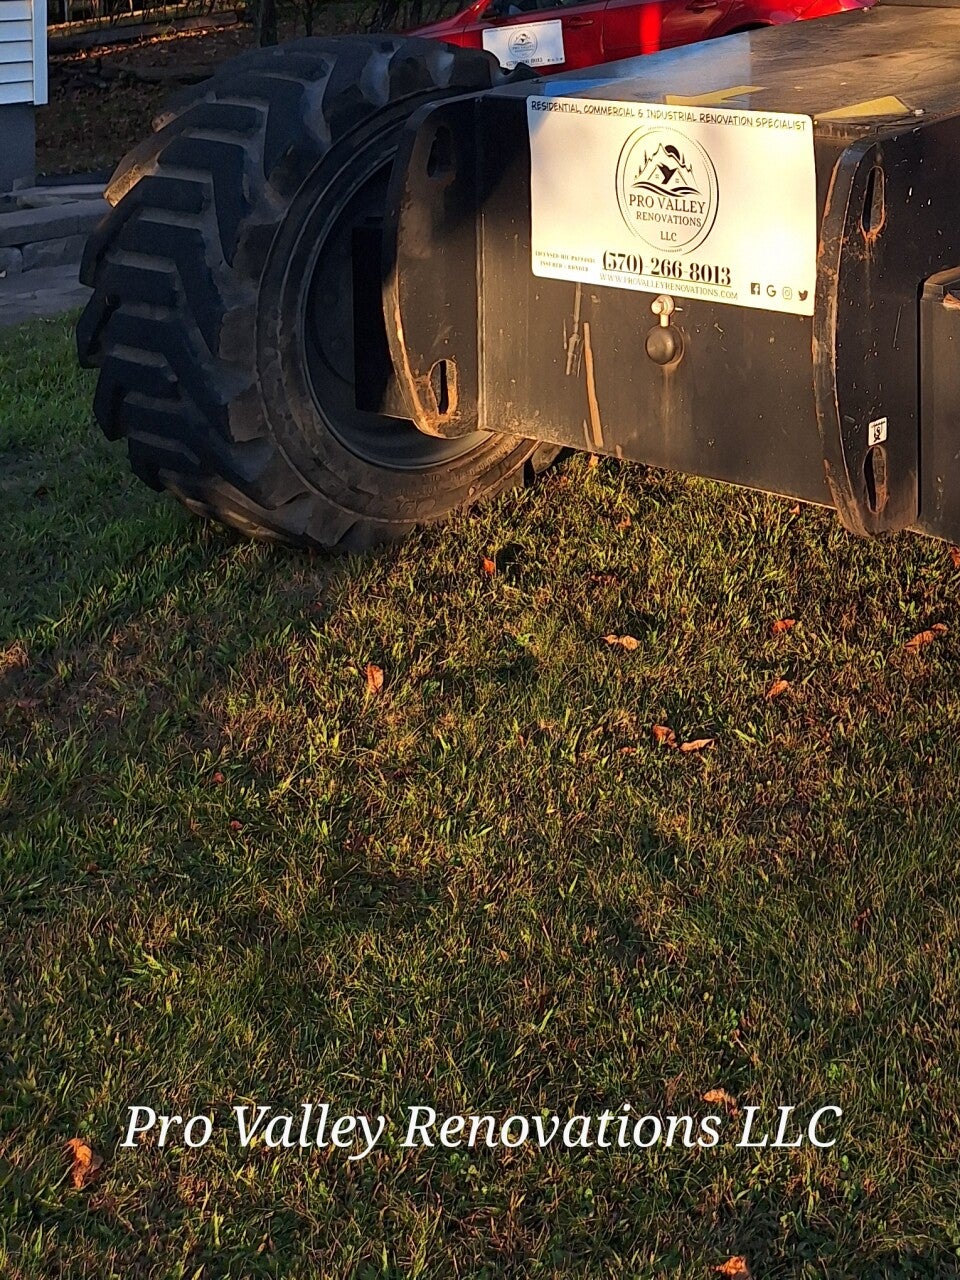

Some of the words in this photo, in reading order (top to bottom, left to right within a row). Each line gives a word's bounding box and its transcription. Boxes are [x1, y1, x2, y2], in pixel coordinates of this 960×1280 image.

[531, 100, 582, 115] RESIDENTIAL,
[583, 104, 635, 118] COMMERCIAL
[637, 108, 644, 118] &
[647, 108, 698, 122] INDUSTRIAL
[699, 112, 753, 128] RENOVATION
[755, 117, 807, 131] SPECIALIST
[628, 193, 655, 209] PRO
[657, 196, 706, 214] VALLEY
[635, 210, 703, 228] RENOVATIONS
[660, 230, 677, 241] LLC
[602, 250, 732, 286] (570)-266-8013
